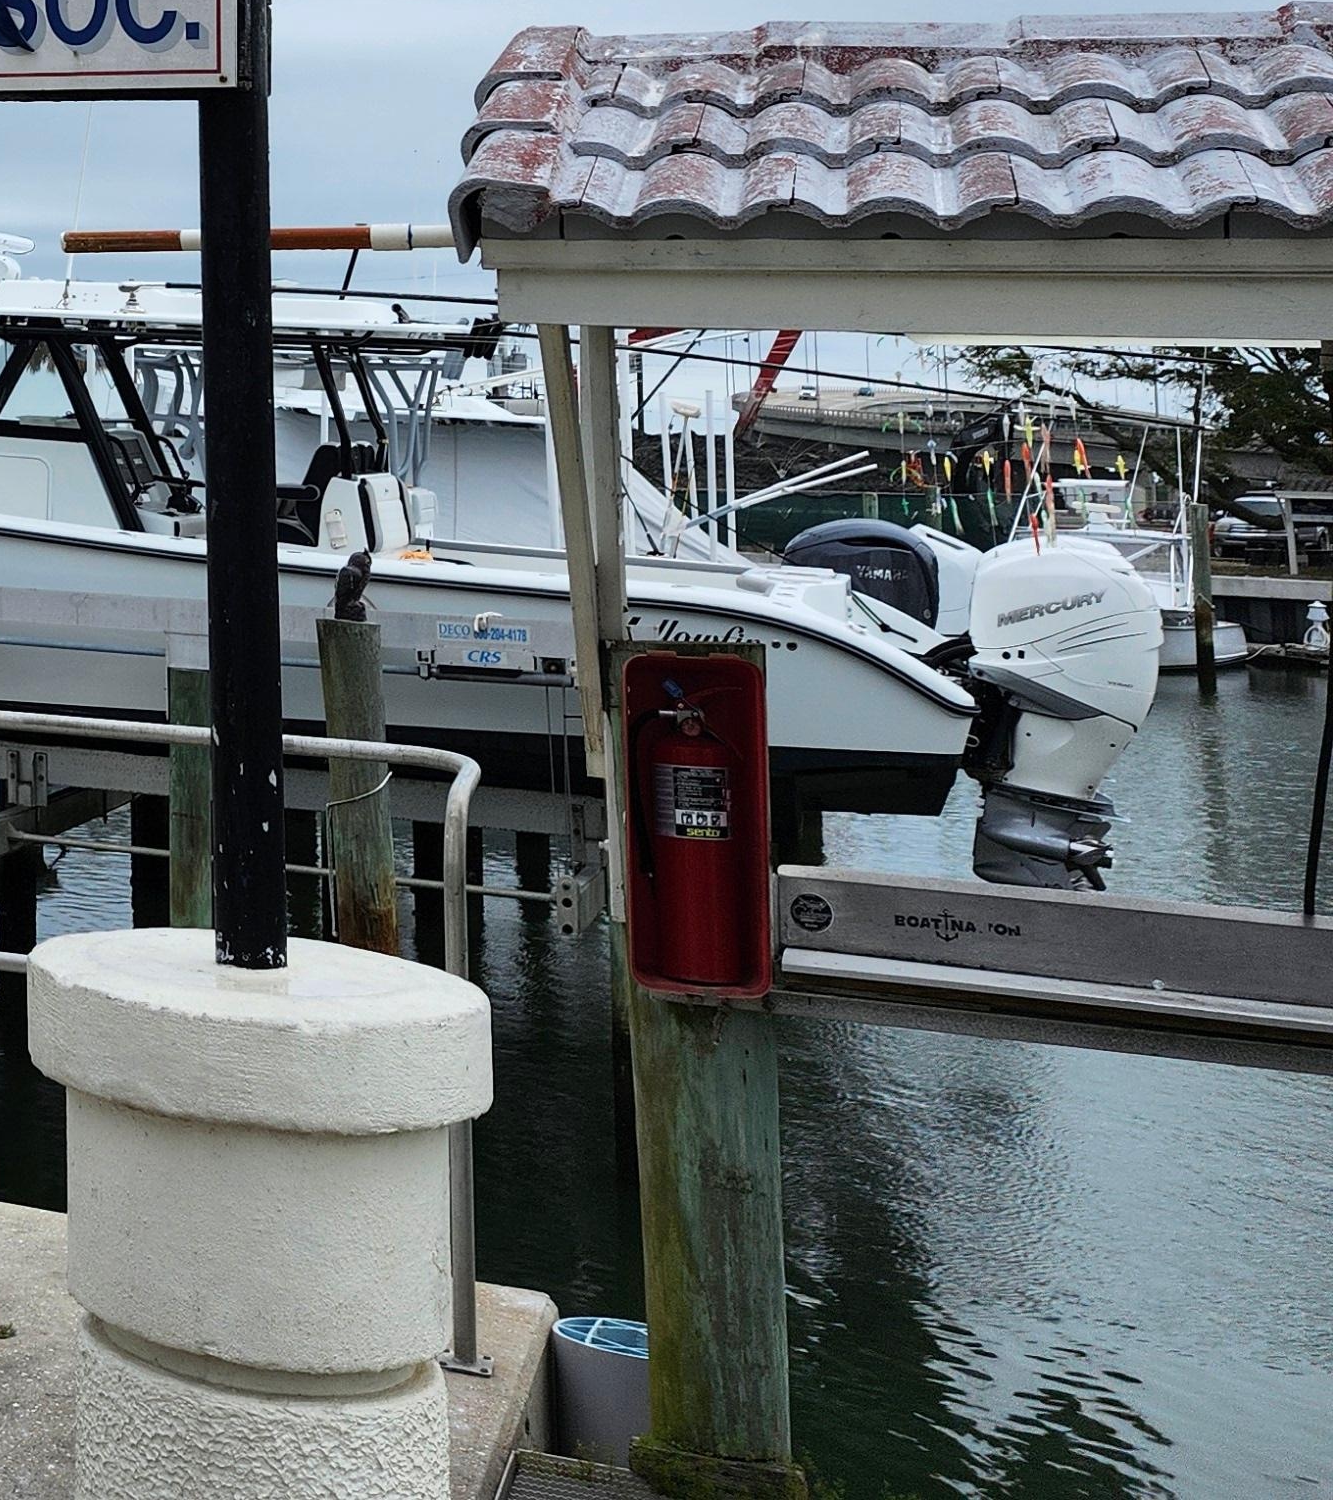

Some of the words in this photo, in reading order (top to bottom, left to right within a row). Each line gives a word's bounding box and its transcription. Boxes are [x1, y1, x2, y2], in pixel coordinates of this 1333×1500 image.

[997, 590, 1107, 628] MERCURY
[438, 623, 471, 636] DECO
[467, 650, 502, 664] CRS
